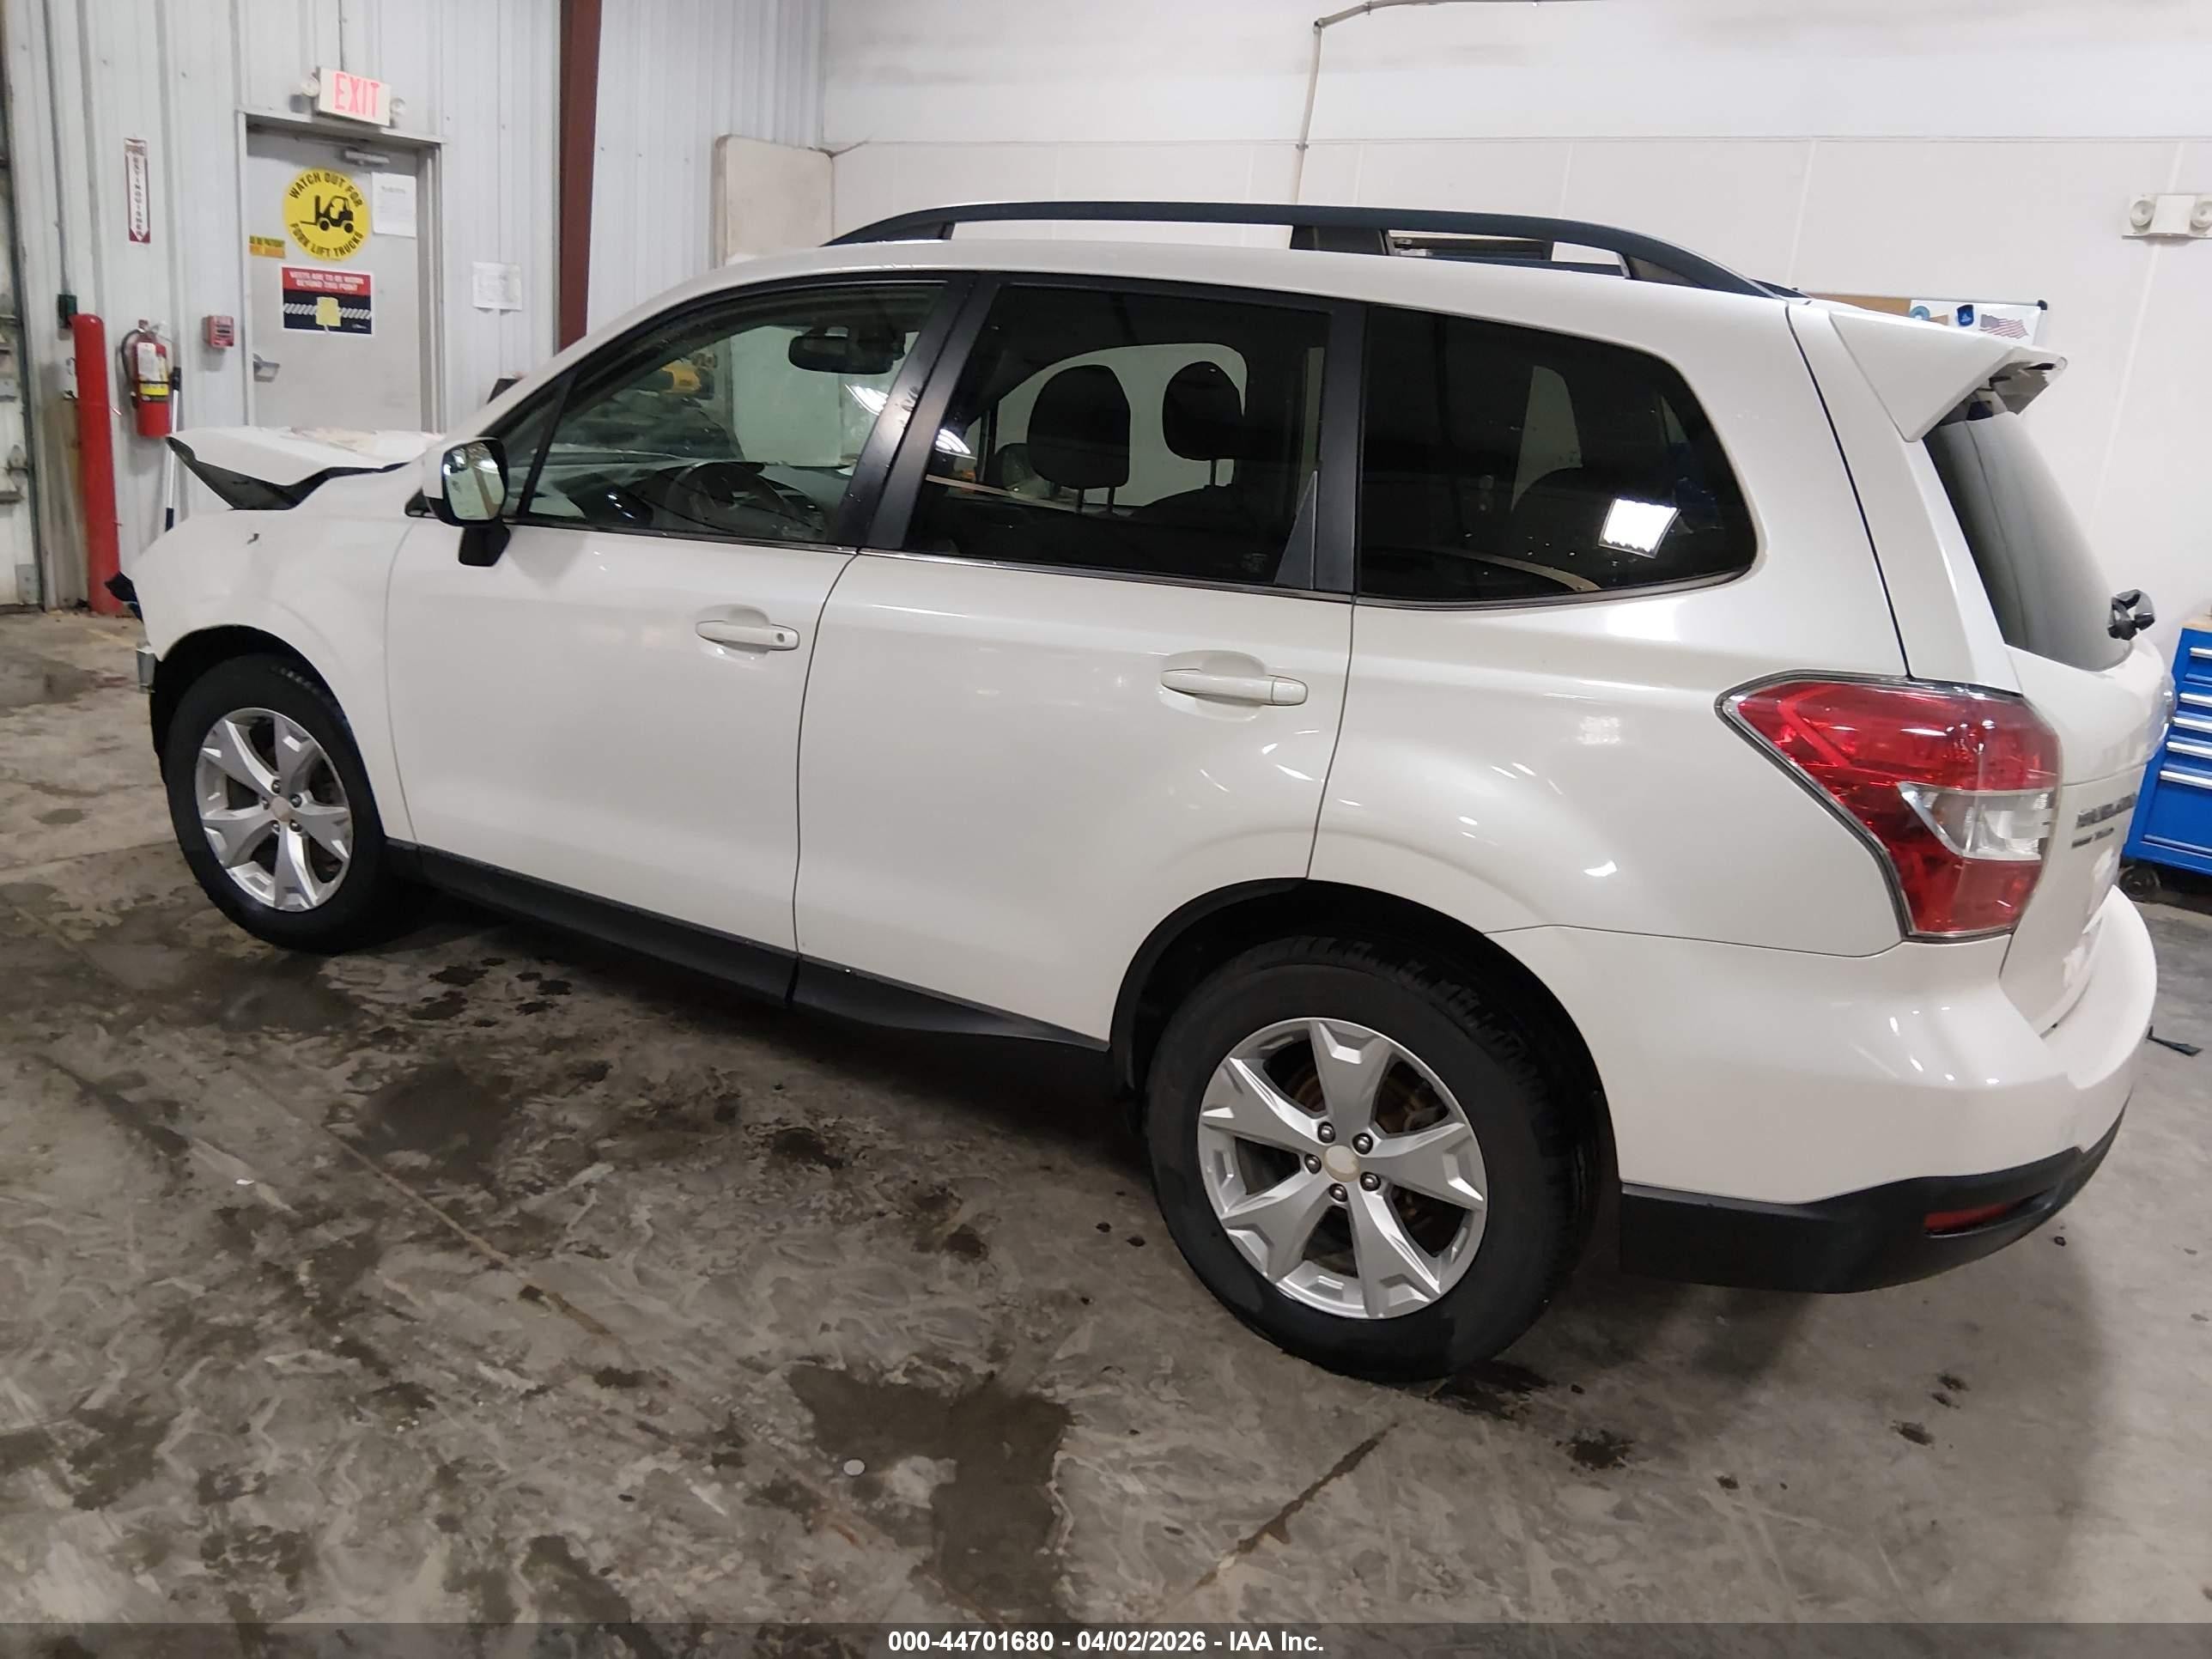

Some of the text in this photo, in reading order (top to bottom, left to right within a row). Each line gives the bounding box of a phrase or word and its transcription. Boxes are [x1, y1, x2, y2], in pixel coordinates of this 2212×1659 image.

[335, 72, 380, 118] EXIT
[289, 172, 364, 207] WATCH OUT FOR
[310, 243, 331, 257] LIFT
[332, 230, 364, 257] TRUCKS
